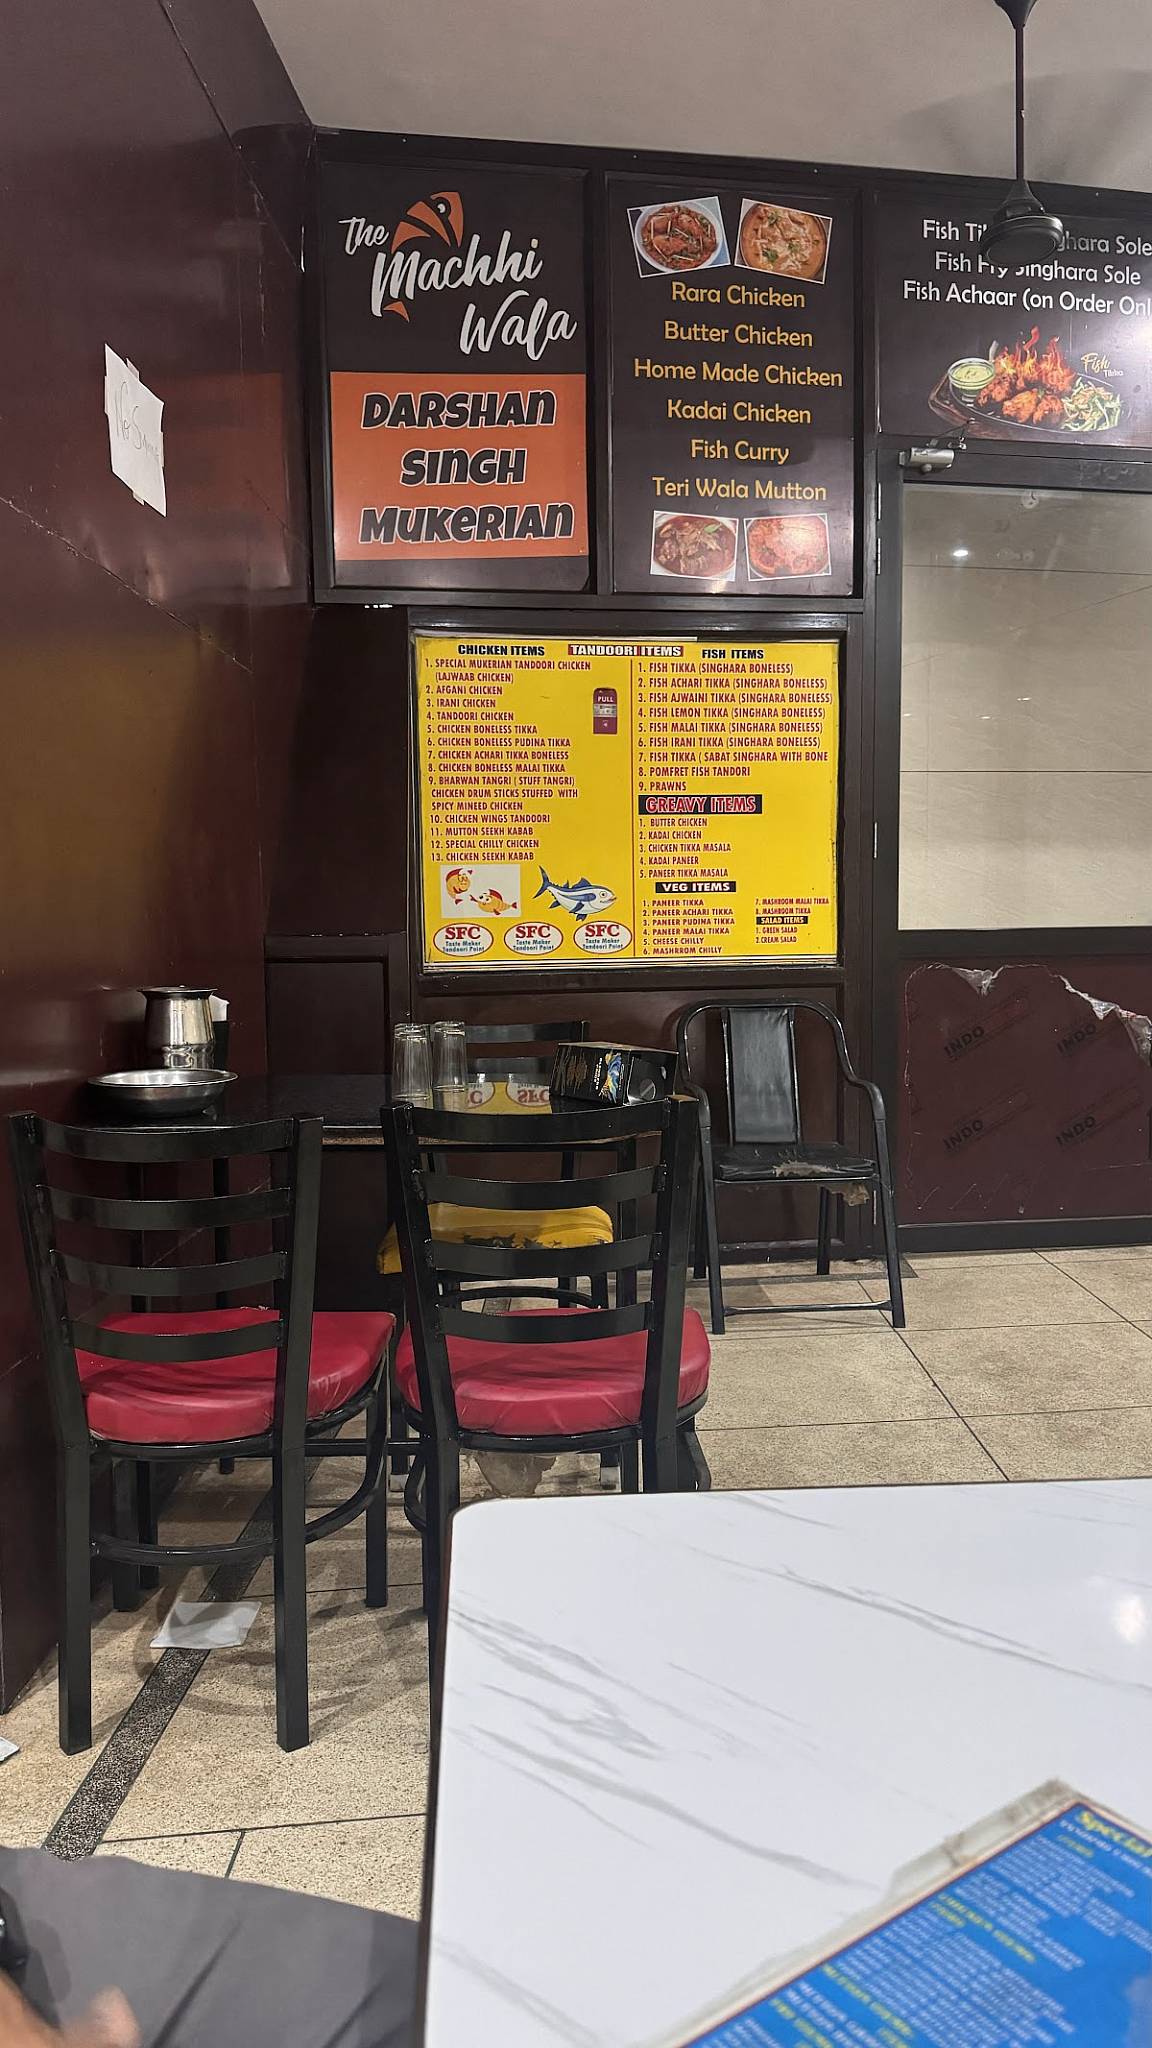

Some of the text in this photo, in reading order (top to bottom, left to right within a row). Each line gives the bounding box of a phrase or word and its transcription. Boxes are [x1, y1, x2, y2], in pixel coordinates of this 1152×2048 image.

[339, 217, 389, 255] The
[923, 219, 960, 241] Fish
[1116, 235, 1152, 256] Sole
[371, 230, 543, 317] Machhi
[935, 251, 972, 273] Fish
[1103, 264, 1142, 285] Sole
[671, 281, 806, 308] Rara Chicken
[903, 279, 1114, 314] Fish Achaar (on Order
[459, 290, 578, 361] Wala
[664, 320, 813, 347] Butter Chicken
[634, 358, 843, 387] Home Made Chicken
[361, 390, 557, 429] DARSHAN
[667, 399, 811, 424] Kadai Chicken
[691, 439, 789, 465] Fish Curry
[399, 448, 528, 487] SINGH
[652, 476, 827, 501] Teri Wala Mutton
[358, 502, 575, 545] MUKERIAN
[458, 645, 544, 656] CHICKEN ITEMS
[570, 645, 681, 656] TANDOORI ITEMS
[702, 650, 763, 659] FISH ITEMS
[436, 659, 590, 670] SPECIAL MUKERIAN TANDOORI CHICKEN
[650, 662, 793, 675] FISH TIKKA (SINGHARA BONELESS)
[436, 672, 513, 684] (LAJWAAB CHICKEN)
[650, 678, 827, 689] FISH ACHARI TIKKA (SINGHARA BONELESS)
[436, 685, 502, 694] AFGANI CHICKEN
[437, 699, 496, 708] IRANI CHICKEN
[650, 693, 832, 704] FISH AJWAINI TIKKA (SINGHARA BONELESS)
[437, 712, 513, 720] TANDOORI CHICKEN
[650, 708, 825, 719] FISH LEMON TIKKA (SINGHARA BONELESS)
[438, 725, 537, 734] CHICKEN BONELESS TIKKA
[650, 722, 822, 734] FISH MALAI TIKKA (SINGHARA BONELESS)
[438, 738, 471, 746] CHICKEN
[474, 738, 512, 746] BONELESS
[548, 738, 570, 746] TIKKA
[650, 737, 820, 748] FISH IRANI TIKKA (SINGHARA BONELESS)
[438, 751, 568, 760] CHICKEN ACHARI TIKKA BONELESS
[650, 752, 668, 762] FISH
[671, 752, 696, 762] TIKKA
[733, 752, 777, 761] SINGHARA
[780, 752, 802, 761] WITH
[806, 752, 828, 761] BONE
[439, 763, 565, 772] CHICKEN BONELESS MALAI TIKKA
[650, 767, 688, 776] POMFRET
[692, 767, 709, 776] FISH
[482, 776, 511, 784] TANGRI
[519, 777, 540, 785] STUFF
[543, 777, 574, 786] TANGRI)
[650, 782, 686, 791] PRAWNS
[432, 789, 577, 797] CHICKEN DRUM STICKS STUFFED WITH
[432, 802, 454, 810] SPICY
[490, 802, 522, 810] CHICKEN
[645, 796, 756, 813] GREAVY ITEMS
[445, 814, 550, 823] CHICKEN WINGS TANDOORI
[651, 818, 707, 827] BUTTER CHICKEN
[446, 827, 533, 836] MUTTON SEEKH KABAB
[649, 831, 701, 839] KADAI CHICKEN
[446, 840, 538, 848] SPECIAL CHILLY CHICKEN
[649, 844, 678, 852] CHICKEN
[680, 844, 700, 852] TIKKA
[446, 852, 534, 861] CHICKEN SEEKH KABAB
[673, 856, 698, 864] PANEER
[649, 869, 728, 878] PANEER TIKKA MASALA
[662, 883, 730, 891] VEG ITEMS
[444, 926, 481, 940] SFC
[515, 925, 551, 939] SFC
[584, 924, 620, 938] SFC
